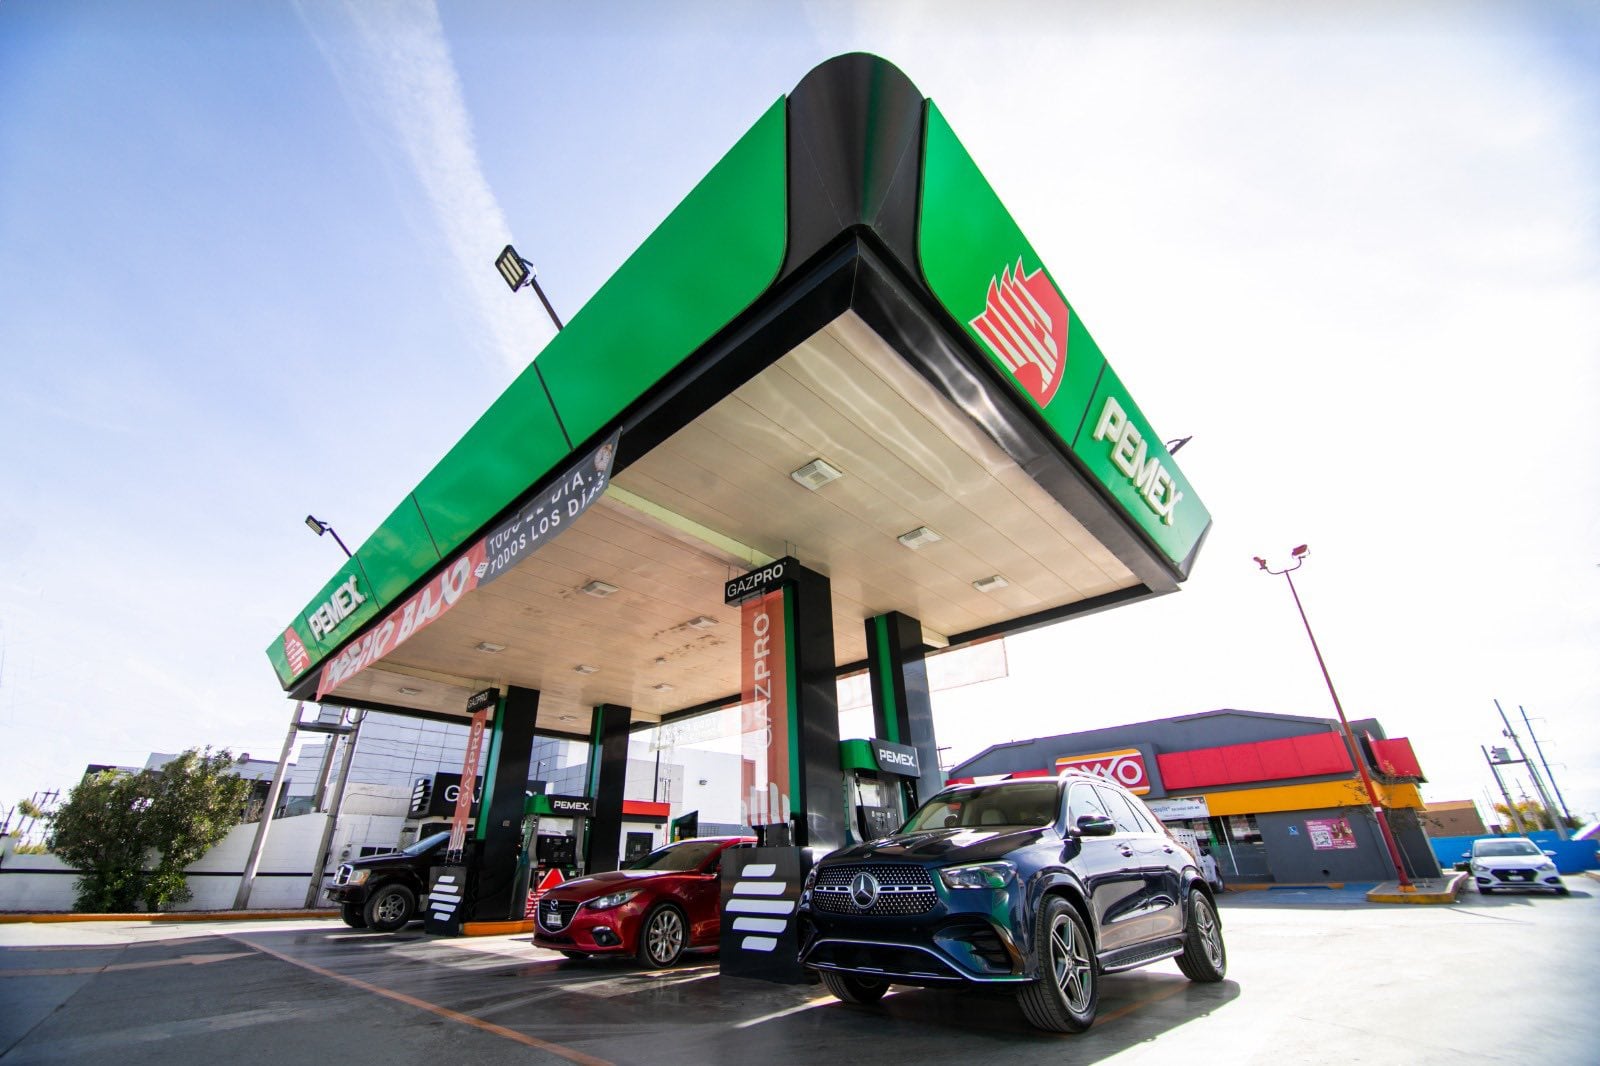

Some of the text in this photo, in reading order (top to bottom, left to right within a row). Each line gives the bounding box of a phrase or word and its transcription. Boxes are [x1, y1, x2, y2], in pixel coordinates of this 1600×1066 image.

[1092, 396, 1184, 527] PEMEX
[490, 533, 527, 575] TODOS
[531, 509, 561, 541] LOS
[309, 574, 367, 643] PEMEX
[727, 562, 785, 598] GAZPRO
[461, 721, 483, 808] GAZPRO
[879, 747, 916, 768] PEMEX
[553, 800, 590, 811] PEMEX
